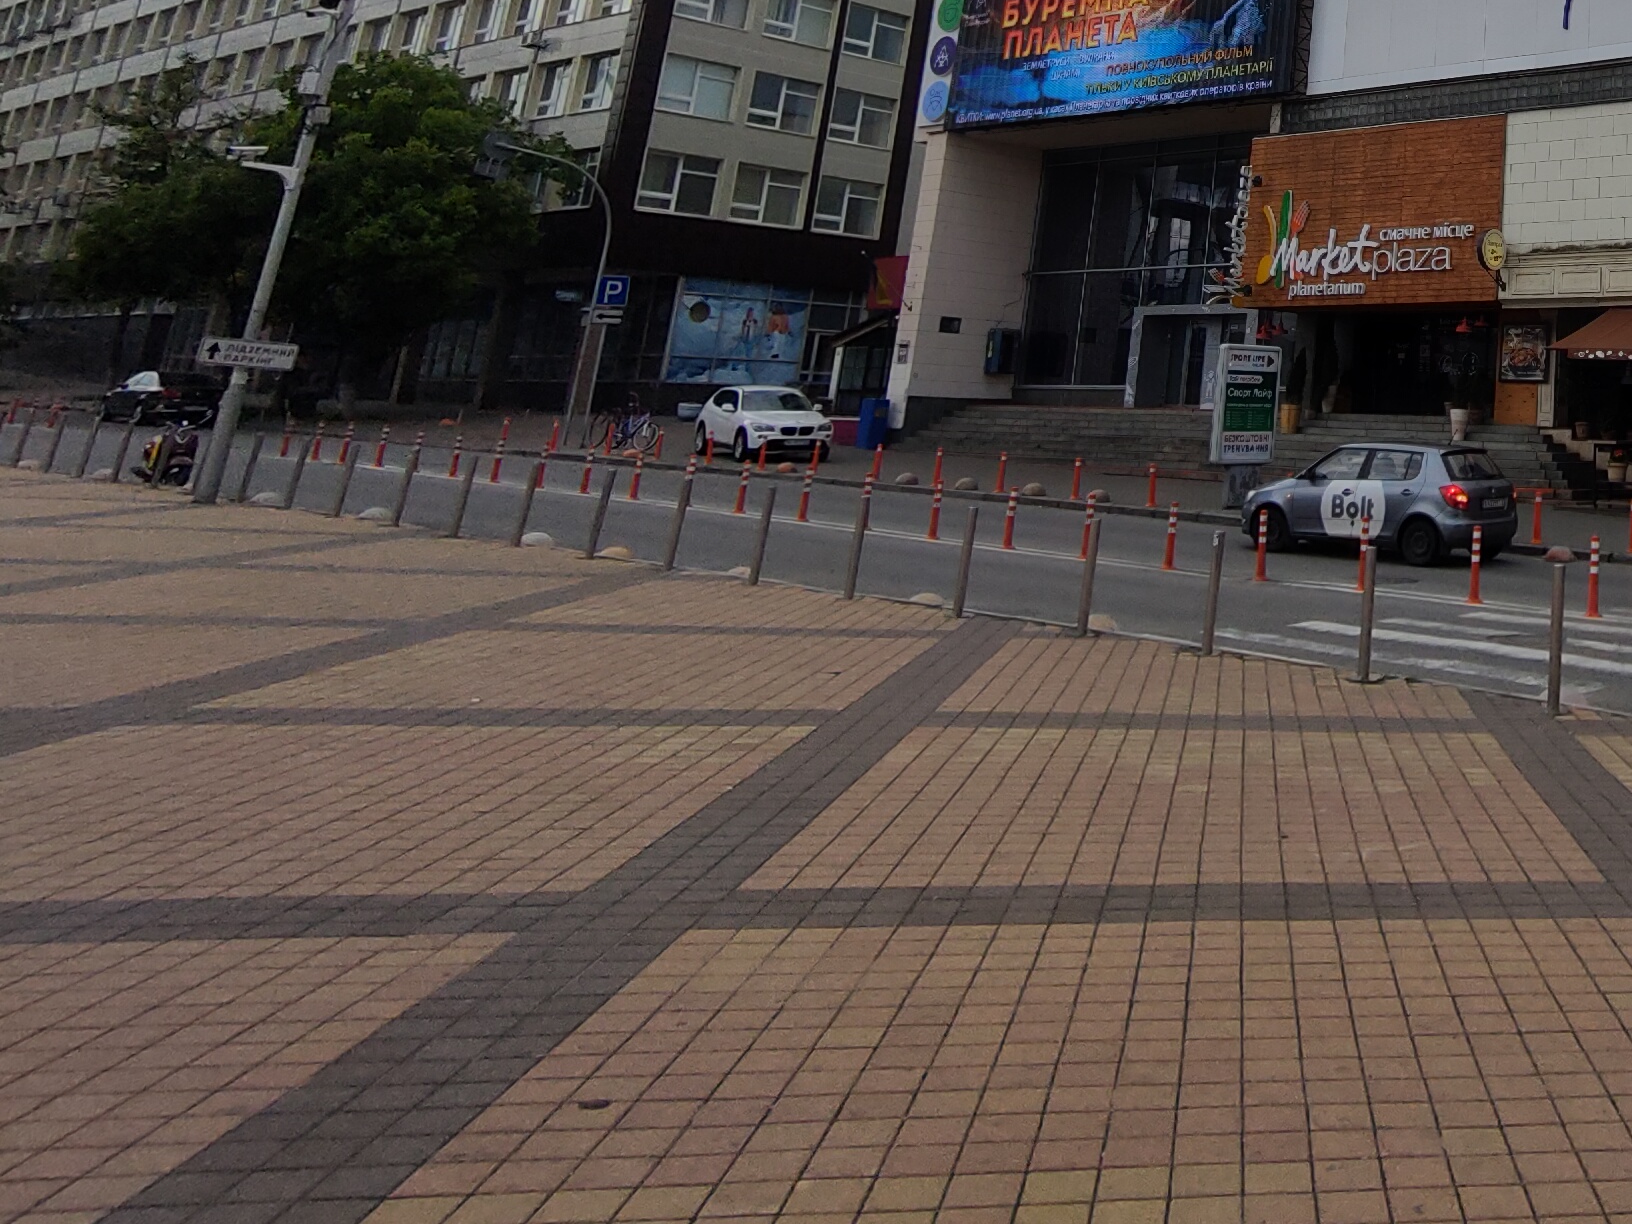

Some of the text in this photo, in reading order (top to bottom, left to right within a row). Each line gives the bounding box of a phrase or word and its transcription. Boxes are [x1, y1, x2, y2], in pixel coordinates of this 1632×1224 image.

[1003, 11, 1138, 60] ПЛАНЕТА
[1106, 44, 1253, 77] ПОВНОКУПОЛЬНИЙ ФІЛЬМ
[1085, 57, 1275, 96] ТІЛЬКИ У КИЇВСЬКОМУ ПЛАНЕТАРІЇ
[1379, 221, 1475, 242] смачне місце
[1270, 224, 1380, 281] Market
[1372, 242, 1453, 280] plaza
[604, 280, 623, 304] P
[1288, 280, 1367, 300] planetarium
[223, 355, 275, 365] ПАРКІНГ
[1227, 387, 1273, 400] Спорт Лайф
[1223, 444, 1269, 454] ТРЕНУВАННЯ
[1224, 434, 1270, 443] БЕЗКОШТОВНІ
[1331, 493, 1375, 520] Bolt
